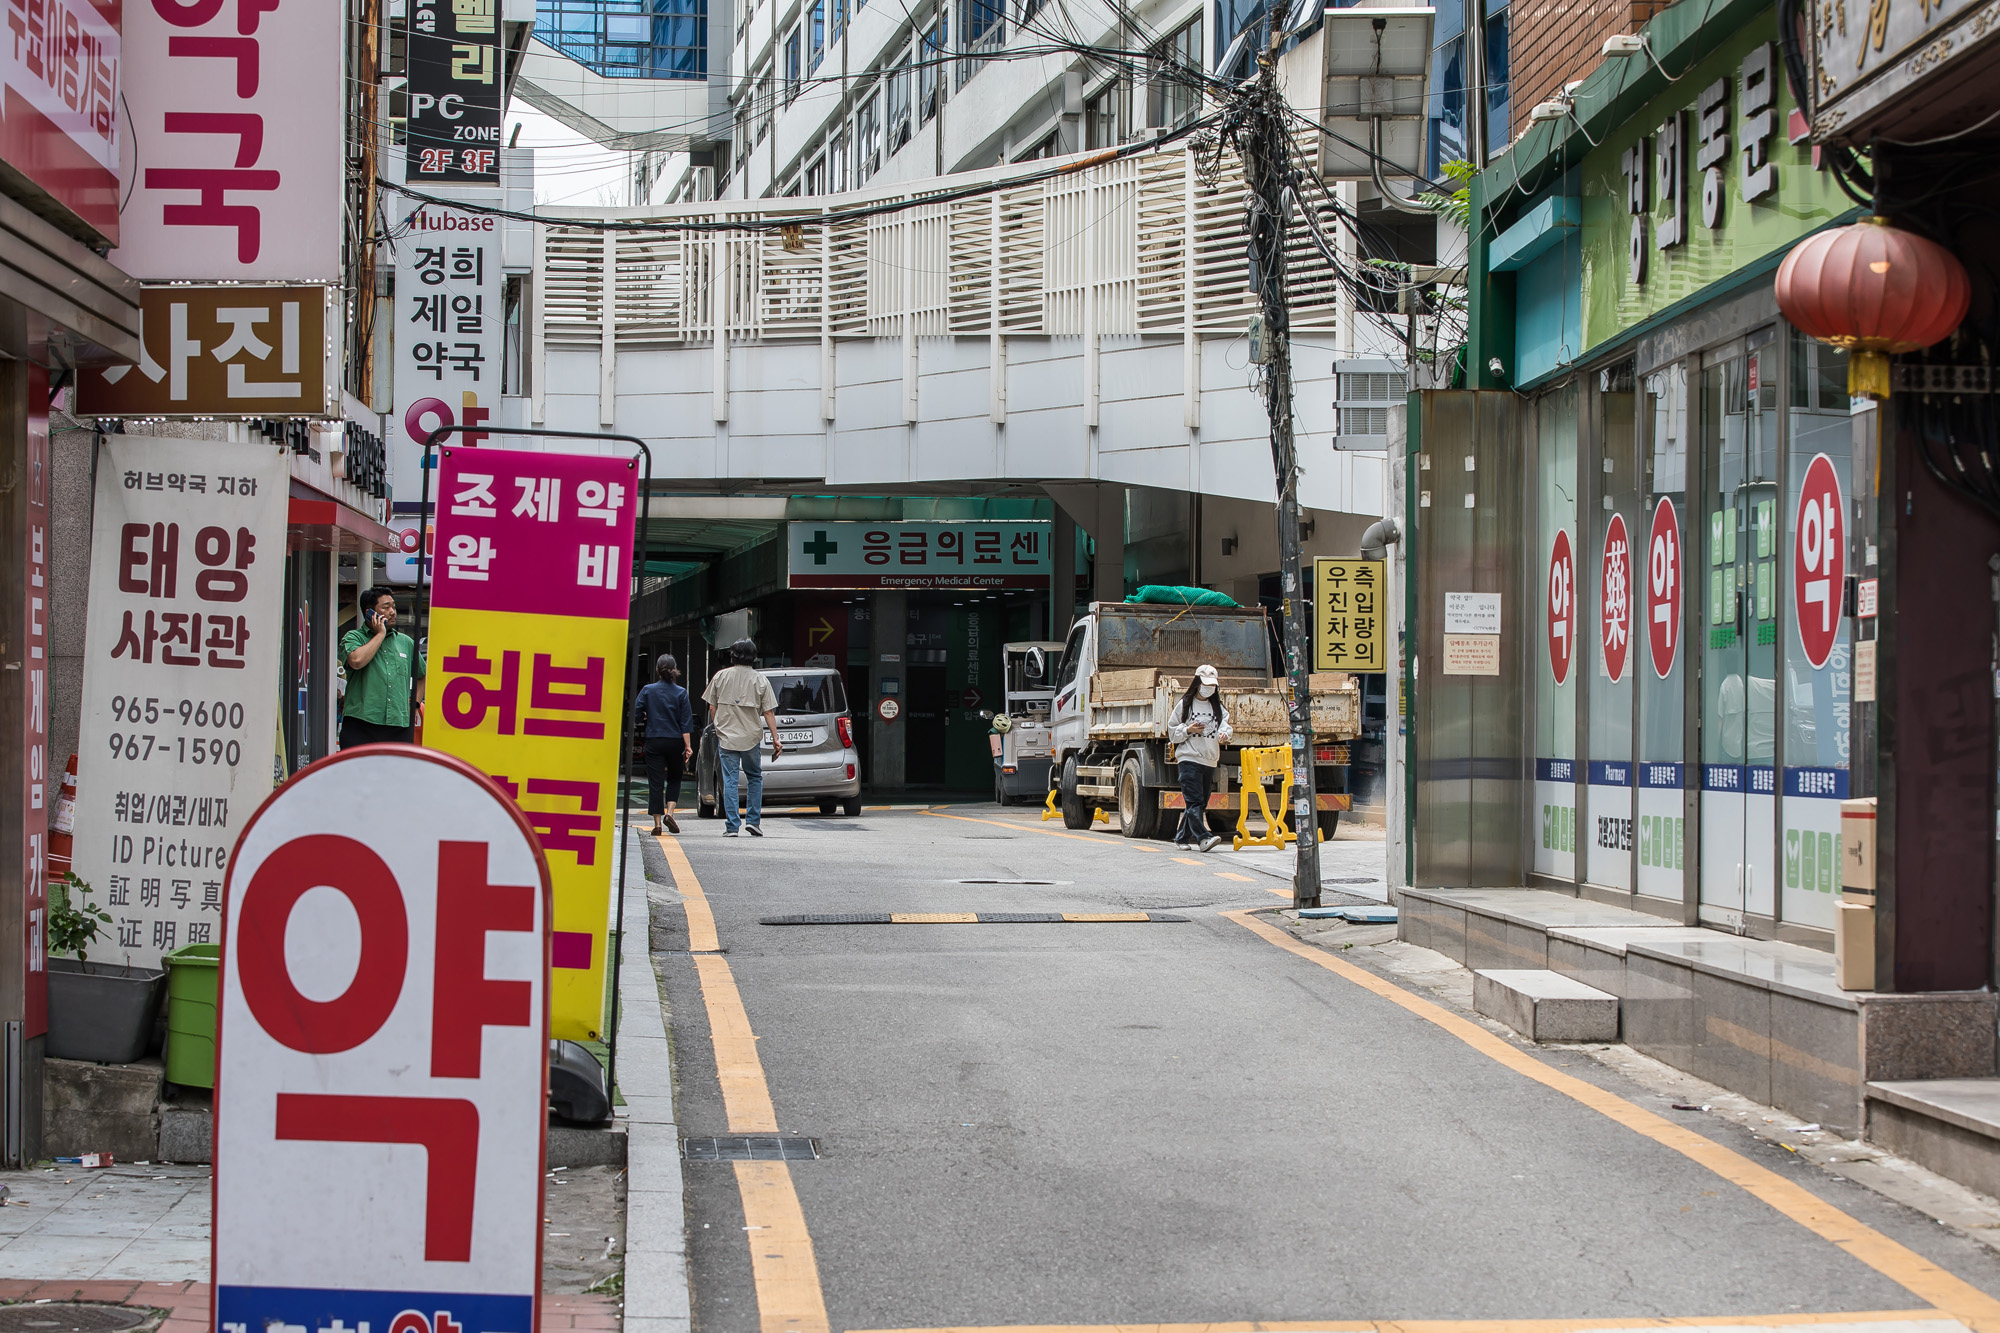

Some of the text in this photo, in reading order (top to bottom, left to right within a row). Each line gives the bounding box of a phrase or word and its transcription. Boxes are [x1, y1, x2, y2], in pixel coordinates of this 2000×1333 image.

[411, 93, 464, 120] PC
[453, 126, 500, 141] ZONE
[420, 148, 495, 174] 2F 3F
[1622, 41, 1778, 284] 경희동문
[410, 211, 494, 231] Hubase
[414, 247, 484, 286] 경희
[411, 294, 484, 334] 제일
[101, 302, 301, 400] 사진
[412, 341, 486, 381] 약국
[123, 470, 258, 496] 허브약국 지하
[118, 521, 256, 603] 태양
[863, 530, 1050, 565] 응급의료센
[1802, 492, 1835, 632] 약
[880, 576, 1005, 587] Emergency Medical Center
[1605, 540, 1626, 650] 藥
[1652, 529, 1674, 648] 약
[1552, 556, 1569, 660] 약
[110, 609, 250, 670] 사진관
[31, 525, 44, 809] 보드게임
[441, 644, 605, 740] 허브
[111, 695, 245, 729] 965-9600
[109, 733, 241, 767] 967-1590
[788, 732, 809, 741] 0496
[1605, 764, 1626, 785] Pharmacy
[114, 791, 228, 828] 취업/여권/비자
[112, 835, 226, 869] ID Picture
[30, 833, 43, 972] 카페
[237, 834, 535, 1262] 약
